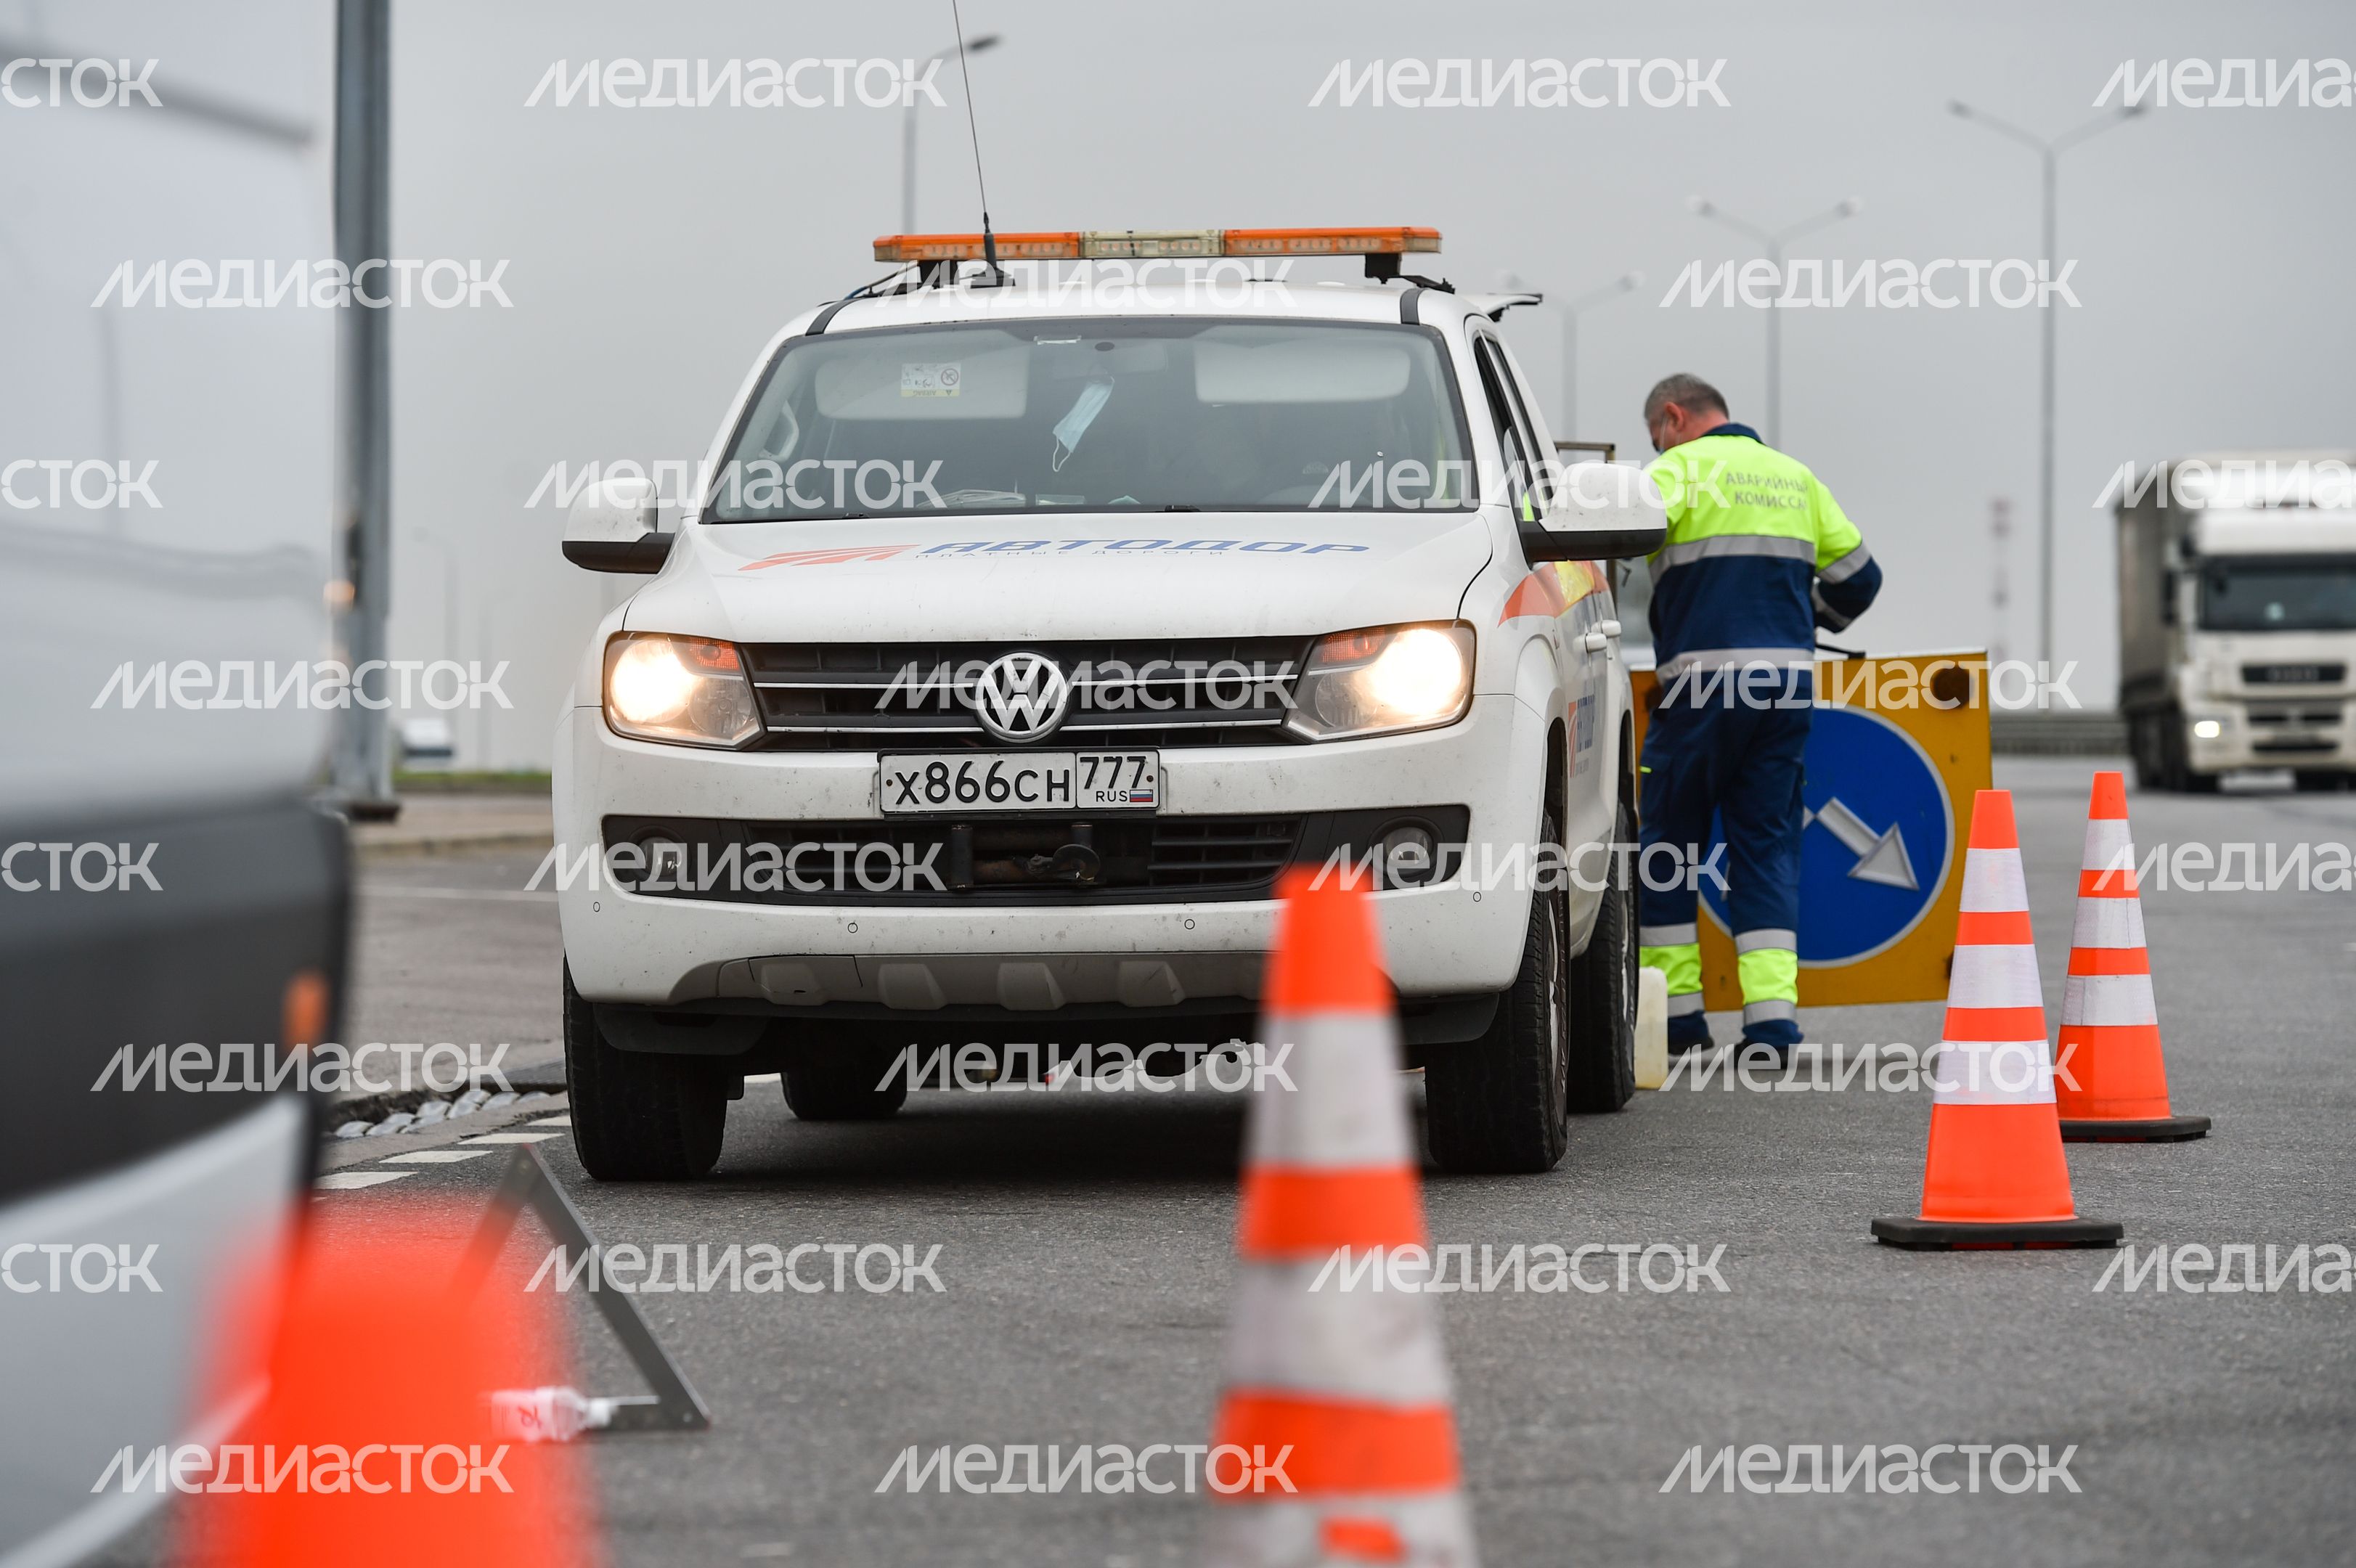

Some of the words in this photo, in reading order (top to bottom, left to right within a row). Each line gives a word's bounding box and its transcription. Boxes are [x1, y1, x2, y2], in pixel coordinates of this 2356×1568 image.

[1726, 472, 1808, 492] АВАРИЙНЫ
[1735, 491, 1806, 510] КОМИССА
[921, 539, 1370, 554] АВТОДОР
[1080, 756, 1146, 790] 777
[1095, 790, 1128, 802] RUS
